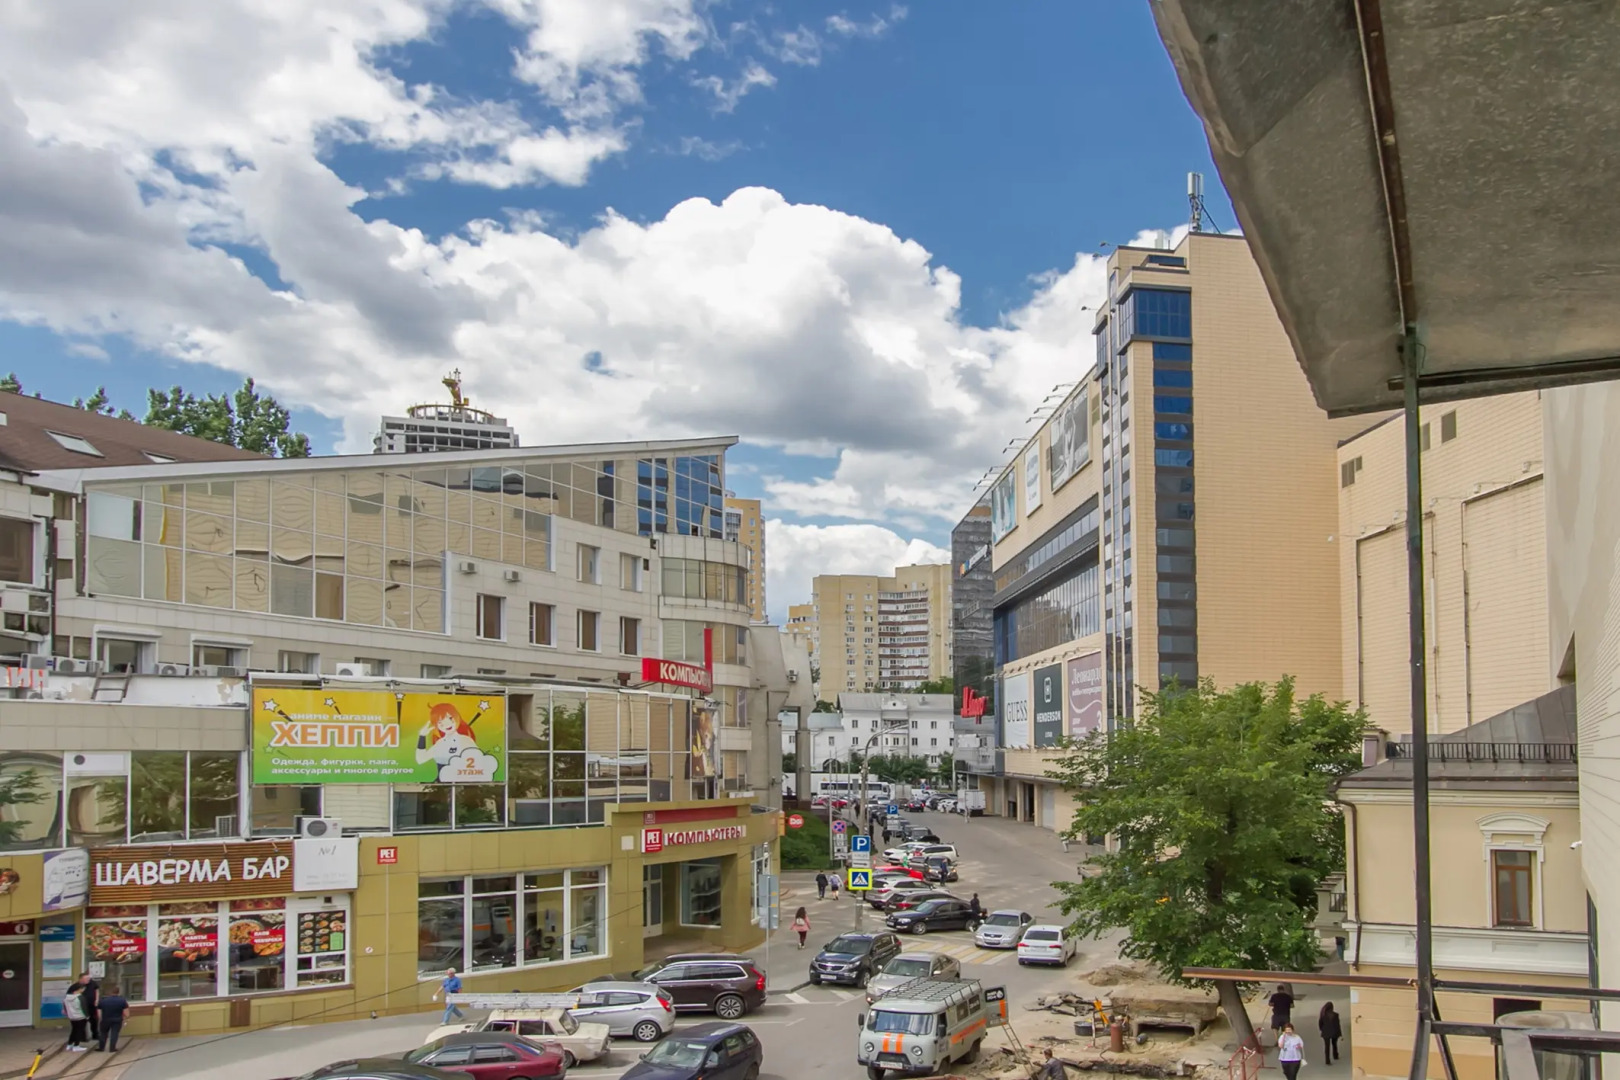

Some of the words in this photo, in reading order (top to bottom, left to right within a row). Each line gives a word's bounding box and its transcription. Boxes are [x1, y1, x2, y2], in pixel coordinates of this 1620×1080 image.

[290, 713, 330, 721] аниме
[333, 713, 383, 722] магазин
[1006, 700, 1028, 723] GUESS
[271, 722, 399, 747] ХЕППИ
[271, 757, 318, 766] Одежда,
[320, 758, 366, 767] фигурки,
[368, 758, 399, 767] манга,
[465, 757, 475, 769] 2
[271, 767, 332, 775] аксессуары
[666, 825, 745, 846] КОМПЬЮТЕРЫ
[856, 837, 868, 851] P
[95, 858, 232, 886] ШАВЕРМА
[242, 855, 289, 881] БАР
